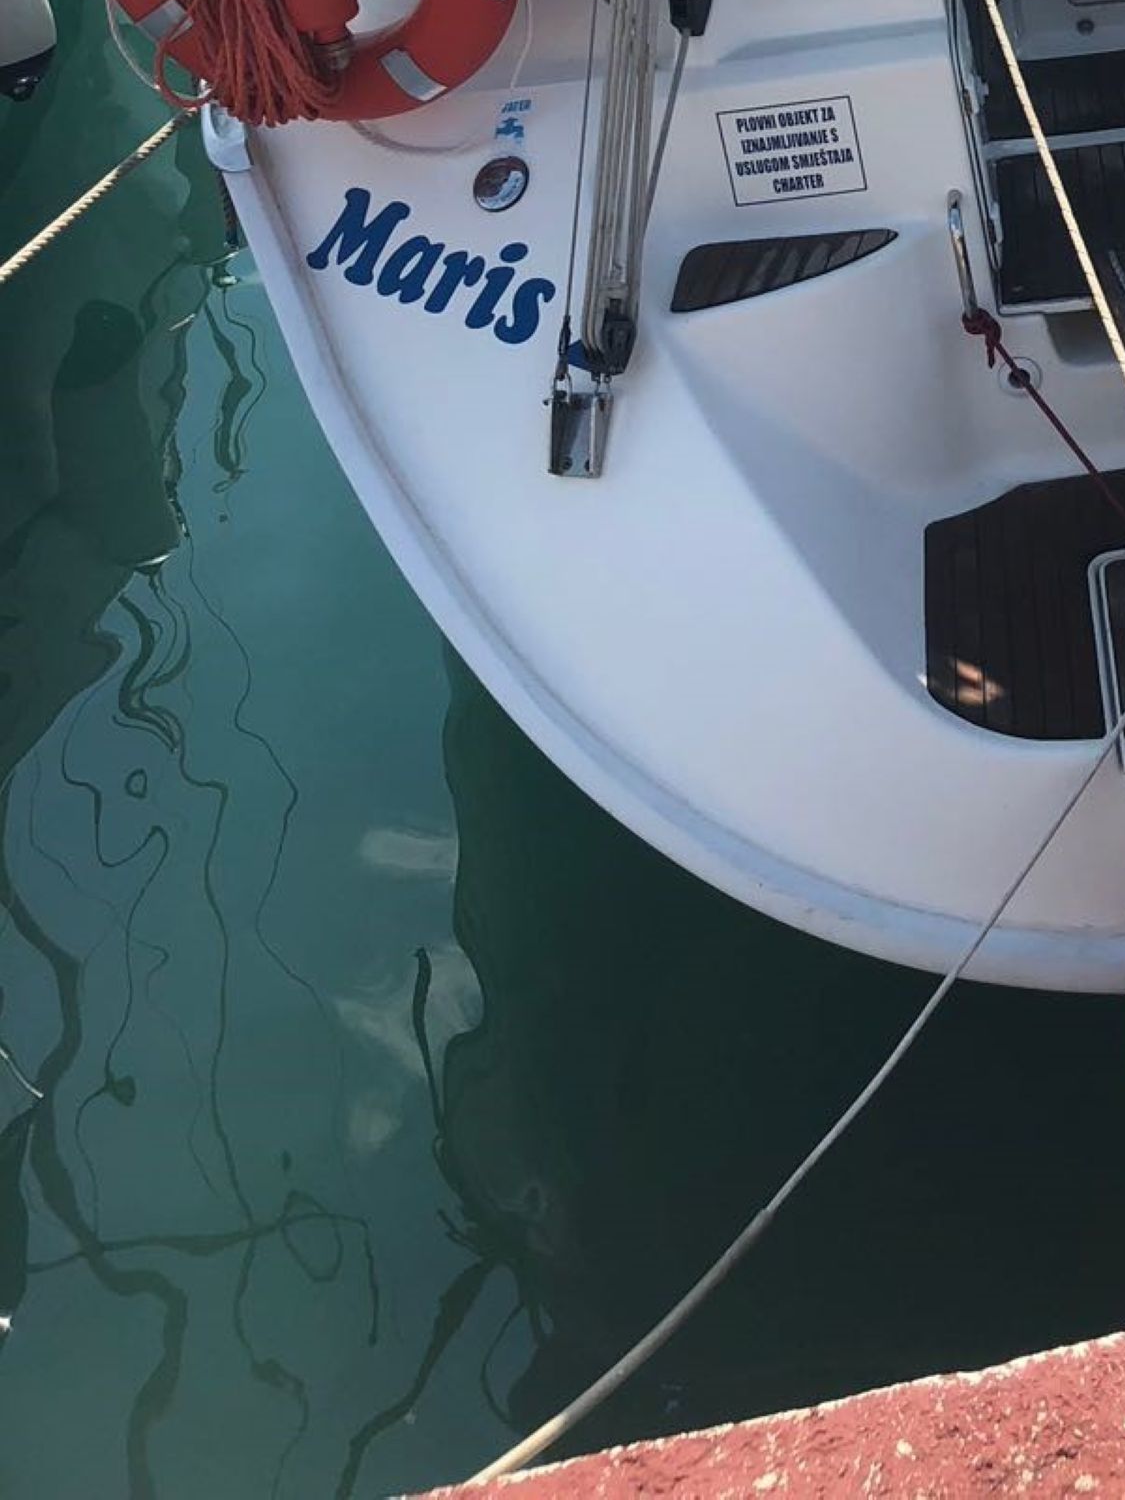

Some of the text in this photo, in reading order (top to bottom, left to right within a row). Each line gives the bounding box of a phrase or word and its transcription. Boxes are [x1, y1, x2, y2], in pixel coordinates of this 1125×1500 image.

[735, 106, 836, 133] PLOVNI OBJEKT ZA
[740, 127, 839, 154] IZNAJMLJIVANJE S
[735, 148, 854, 177] USLUGOM SMJEŠTAJA
[772, 173, 825, 194] CHARTER
[306, 187, 556, 345] Maris
